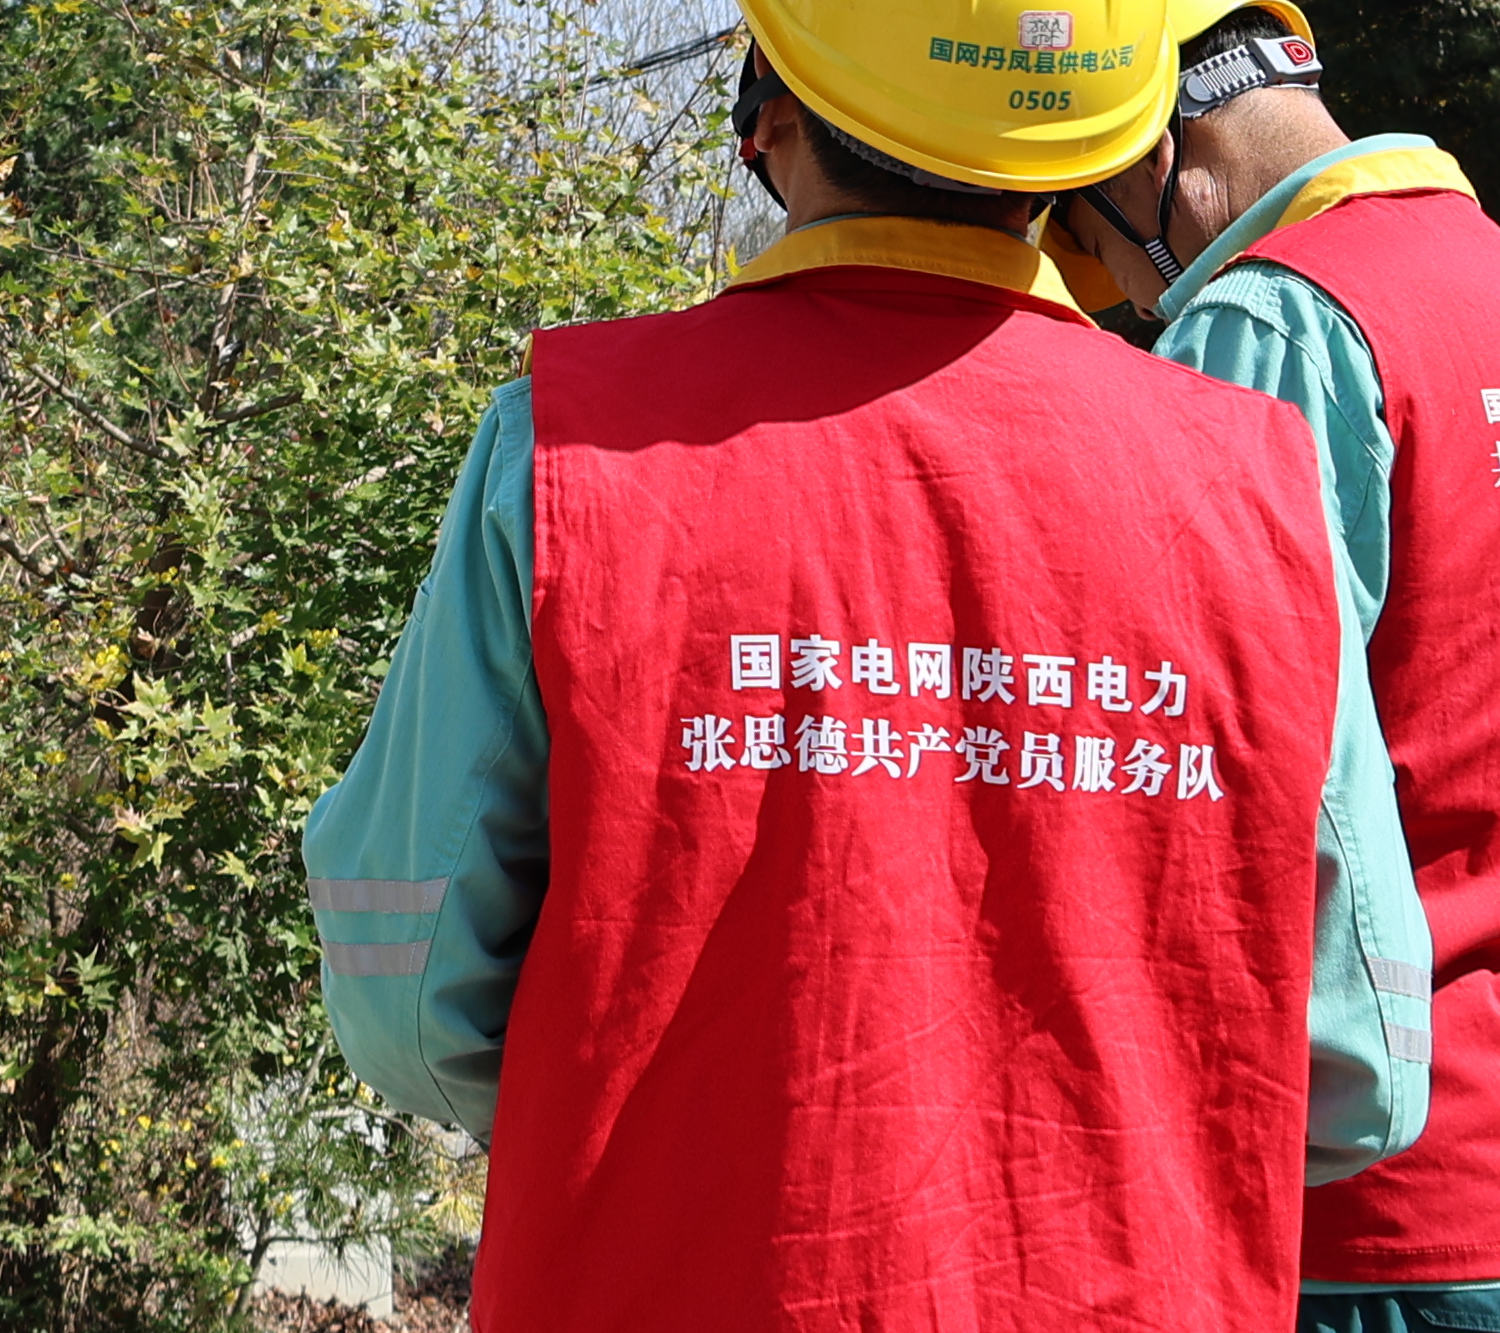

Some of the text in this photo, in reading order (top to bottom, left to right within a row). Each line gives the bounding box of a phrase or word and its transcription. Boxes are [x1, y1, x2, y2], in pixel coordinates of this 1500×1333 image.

[929, 37, 1135, 74] 国网丹凤县供电公司
[1009, 90, 1072, 110] 0505
[730, 634, 1187, 717] 国家电网陕西电力
[680, 713, 1224, 801] 张思德共产党员服务队
